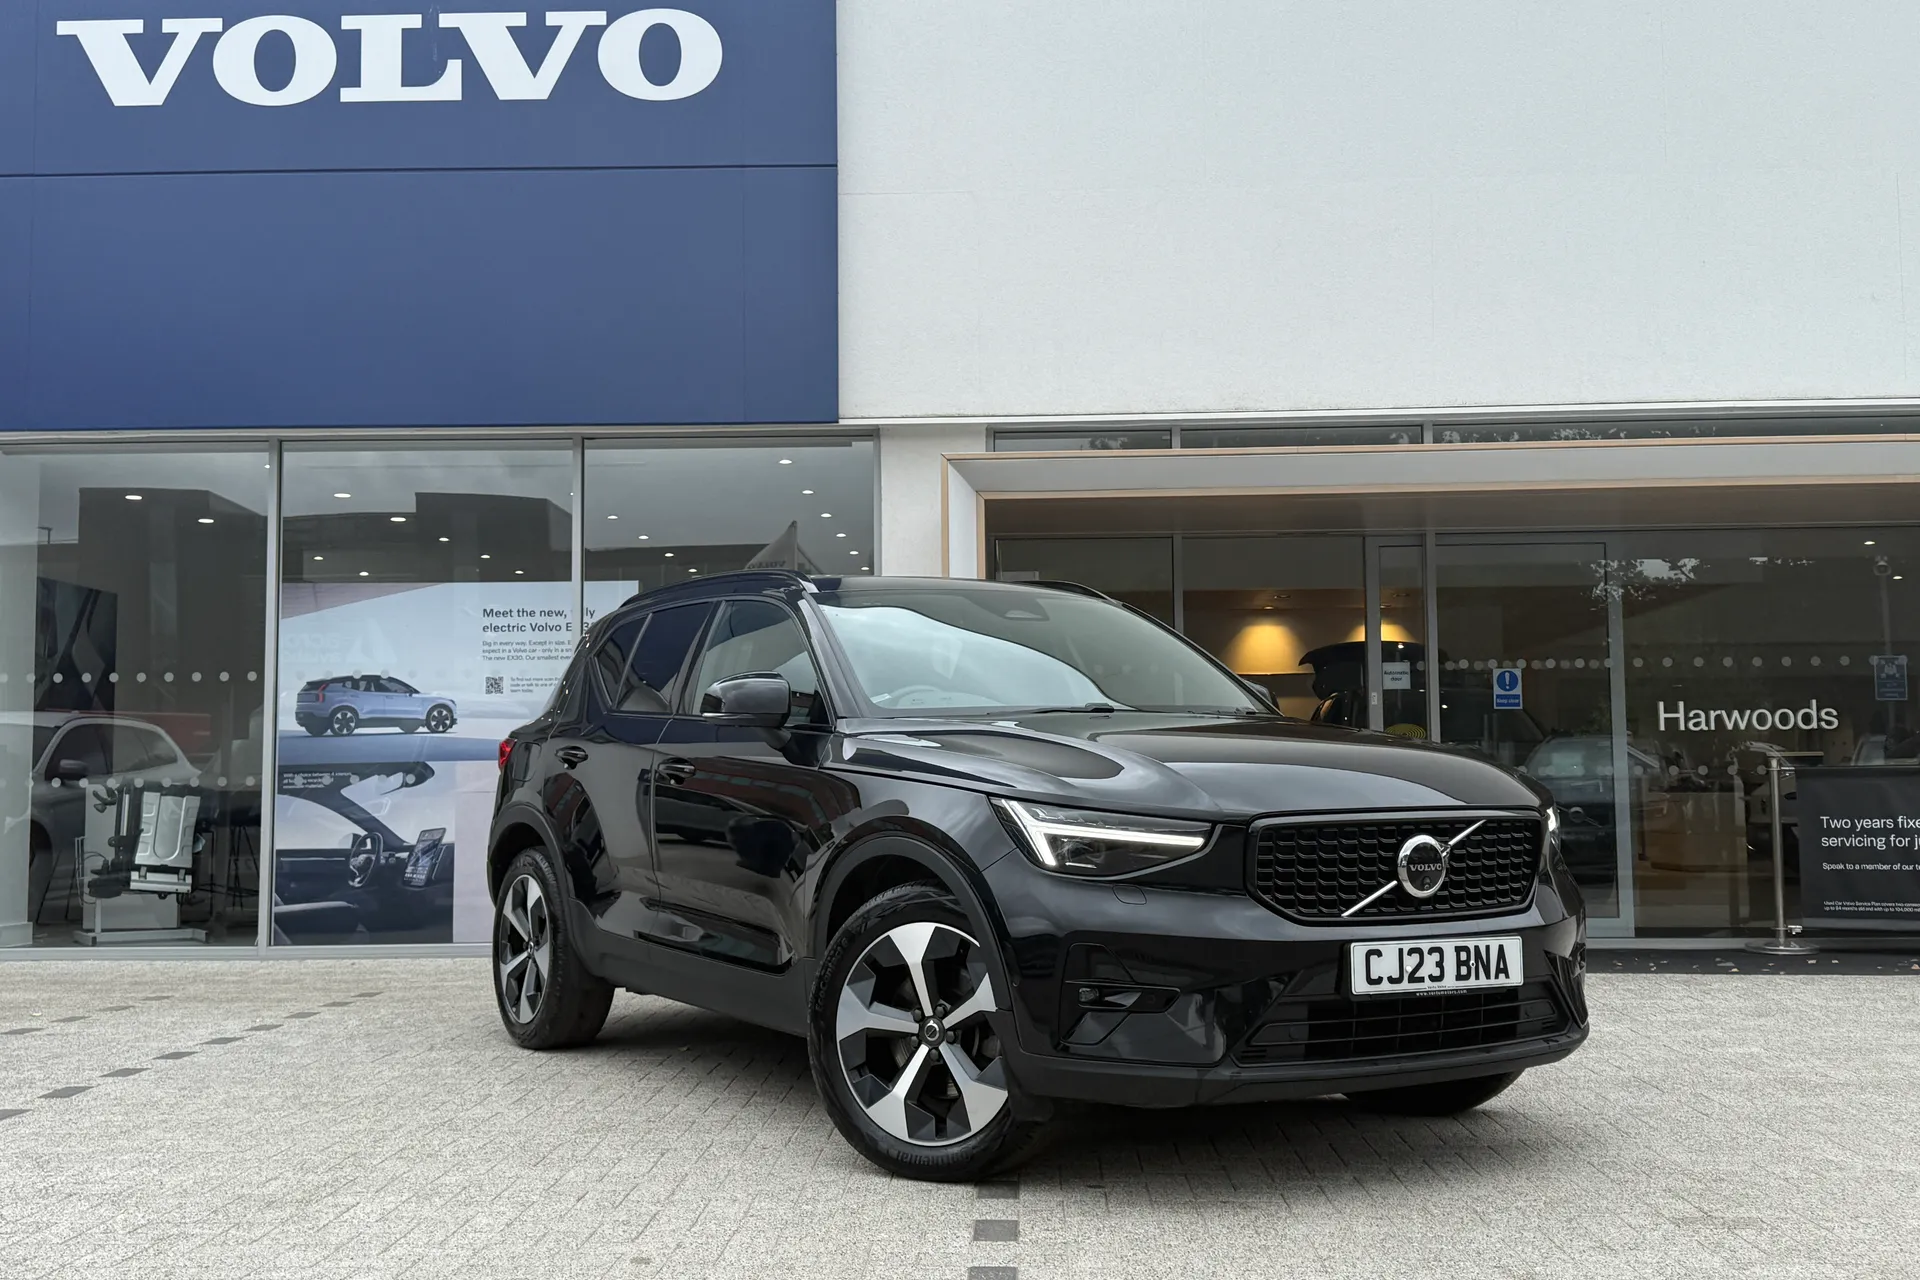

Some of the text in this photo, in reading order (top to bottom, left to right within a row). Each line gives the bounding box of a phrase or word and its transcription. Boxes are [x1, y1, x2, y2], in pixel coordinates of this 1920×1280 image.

[56, 8, 723, 107] VOLVO
[482, 608, 514, 618] Meet
[516, 608, 536, 618] the
[540, 609, 567, 619] new,
[482, 622, 526, 632] electric
[530, 622, 562, 632] Volvo
[1658, 699, 1839, 732] Harwoods
[1820, 816, 1852, 829] Two
[1854, 818, 1894, 832] years
[1821, 834, 1920, 850] servicing for j
[1410, 862, 1442, 872] VOLVO
[1822, 862, 1845, 870] Speak
[1364, 944, 1510, 985] CJ23 BNA
